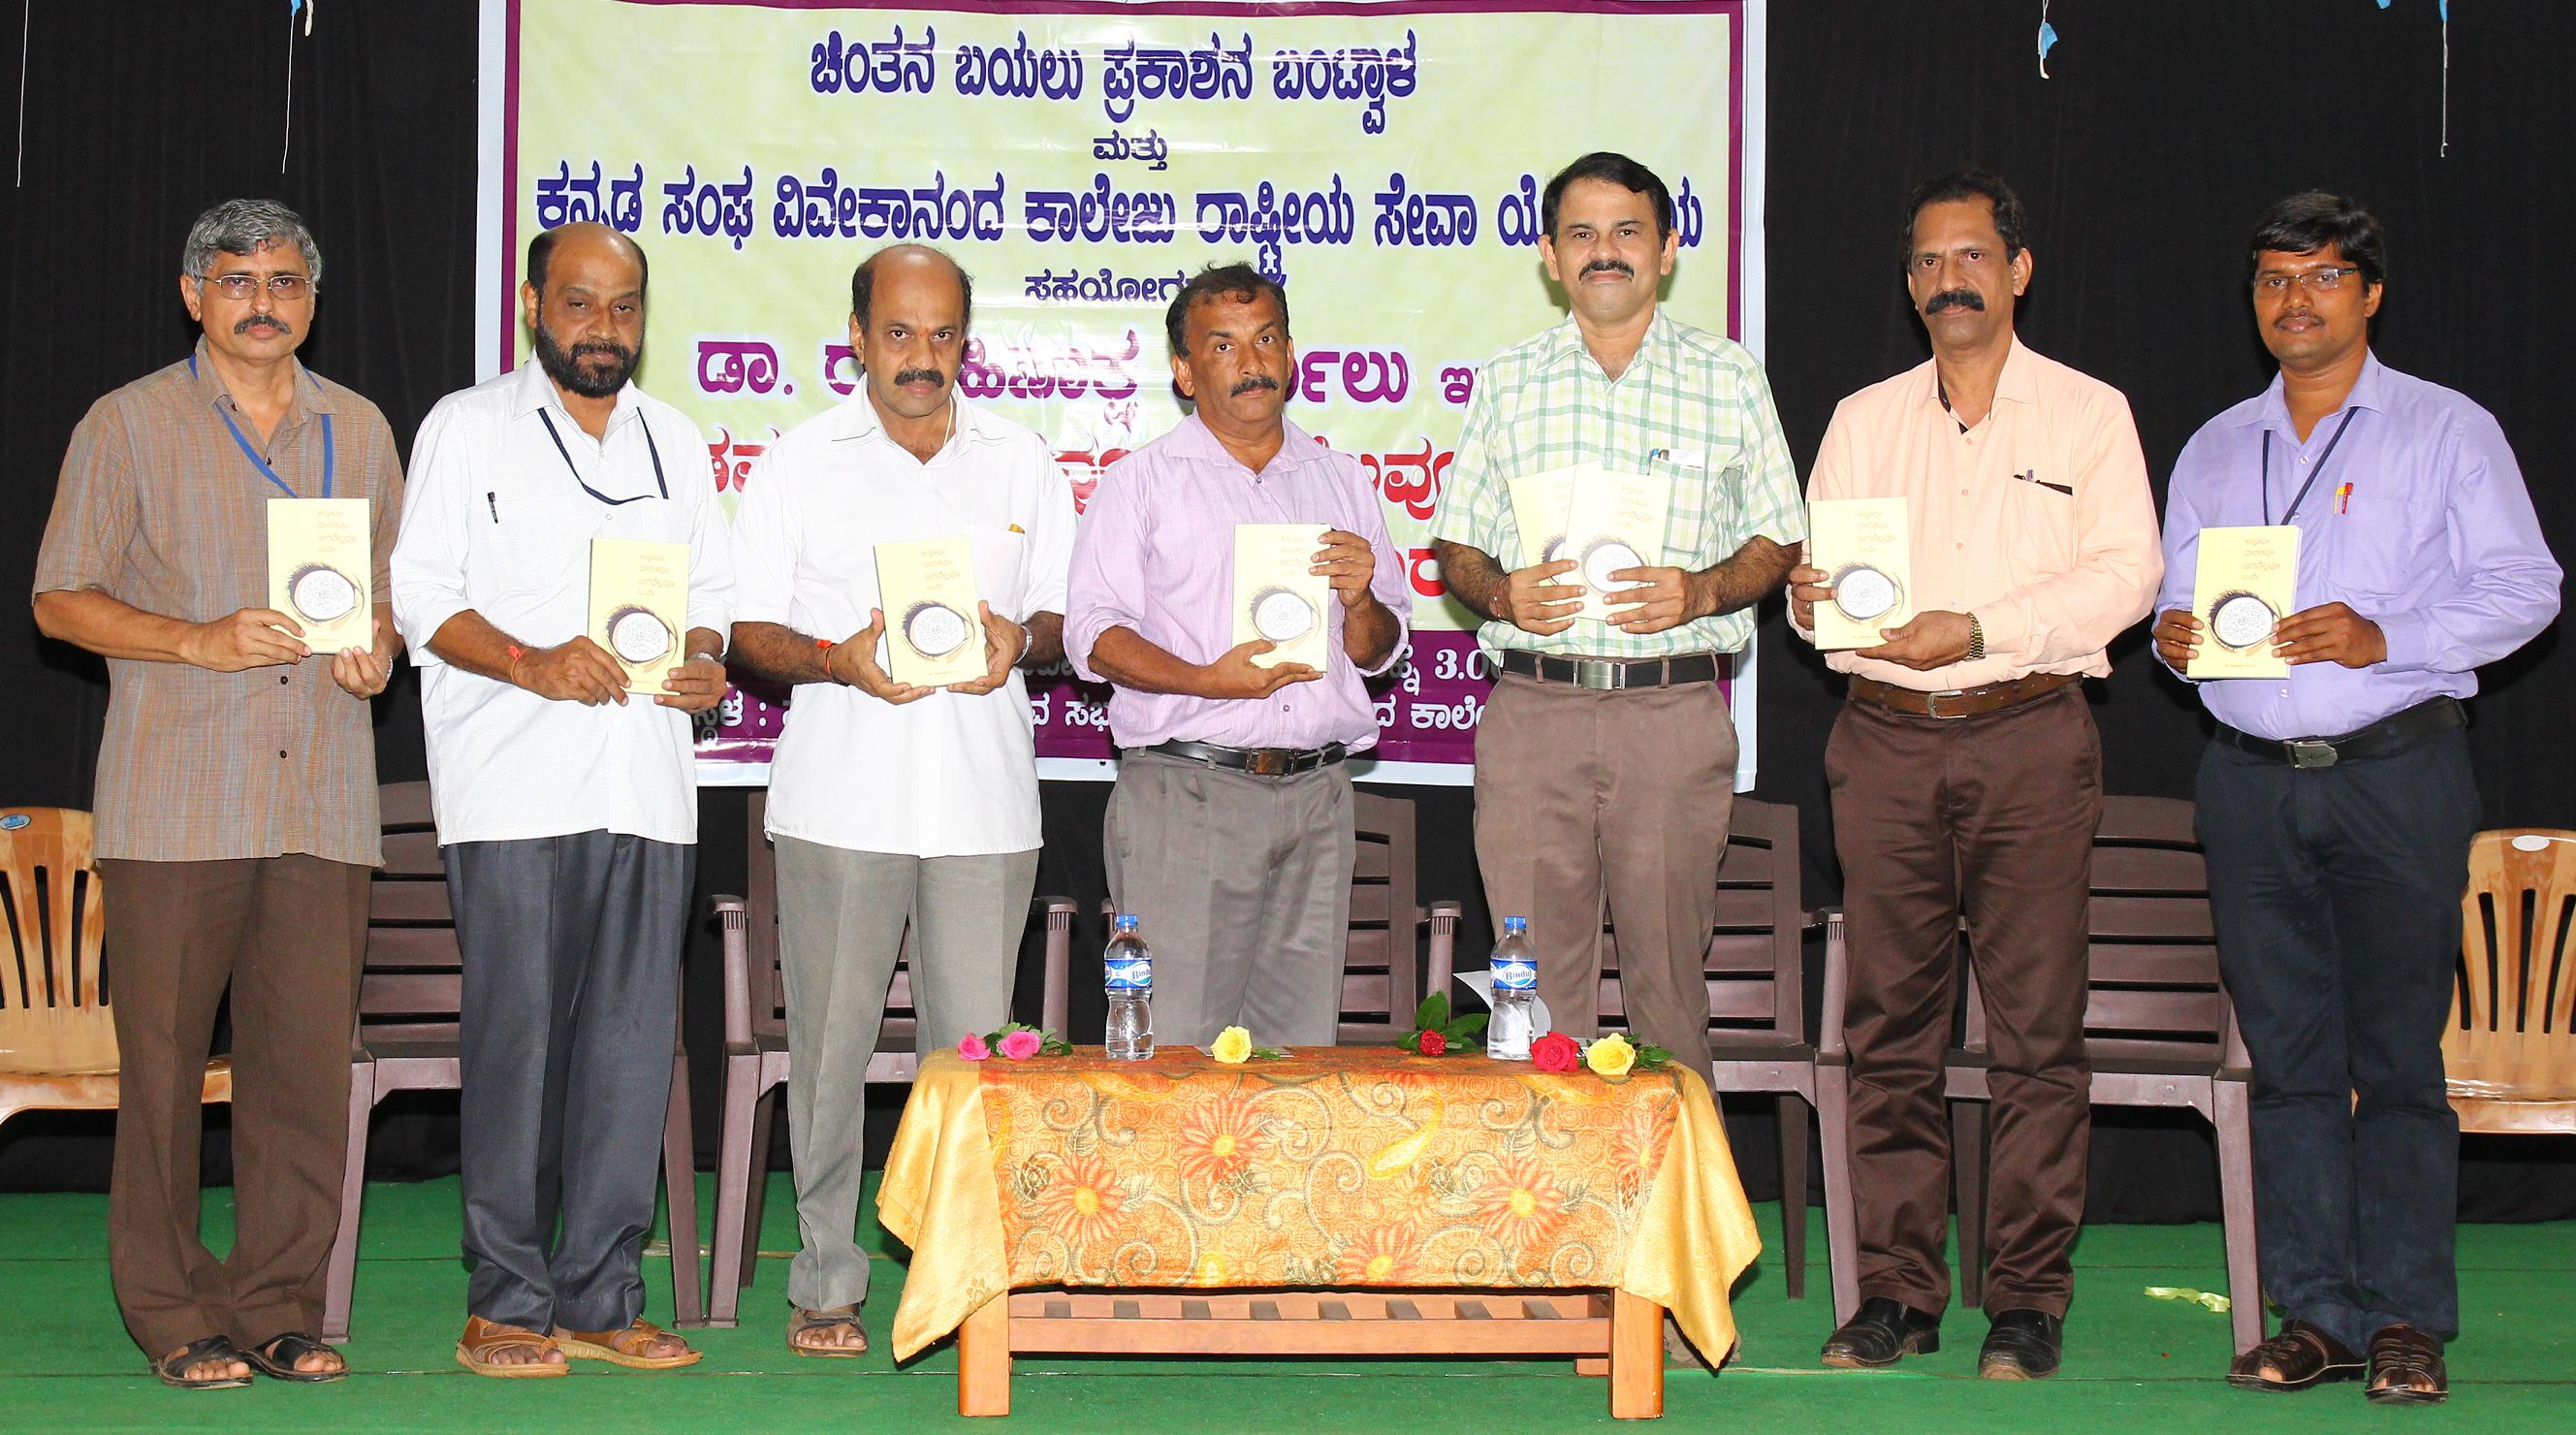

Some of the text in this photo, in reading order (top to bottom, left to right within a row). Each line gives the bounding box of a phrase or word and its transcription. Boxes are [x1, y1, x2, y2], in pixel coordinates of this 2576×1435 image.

[811, 24, 1417, 135] ಚಿಂತನ ಬಯಲು ಪ್ರಕಾಶನ ಬಂಟ್ವಾಳ
[1093, 129, 1168, 171] ಮತ್ತು
[662, 164, 753, 250] ಸಂಘ
[773, 168, 1004, 241] ವಿವೇಕಾನಂದ
[1025, 173, 1176, 242] ಕಾಲೇಜು
[1373, 173, 1477, 248] ಸೇವಾ
[697, 339, 794, 396] ಡಾ.
